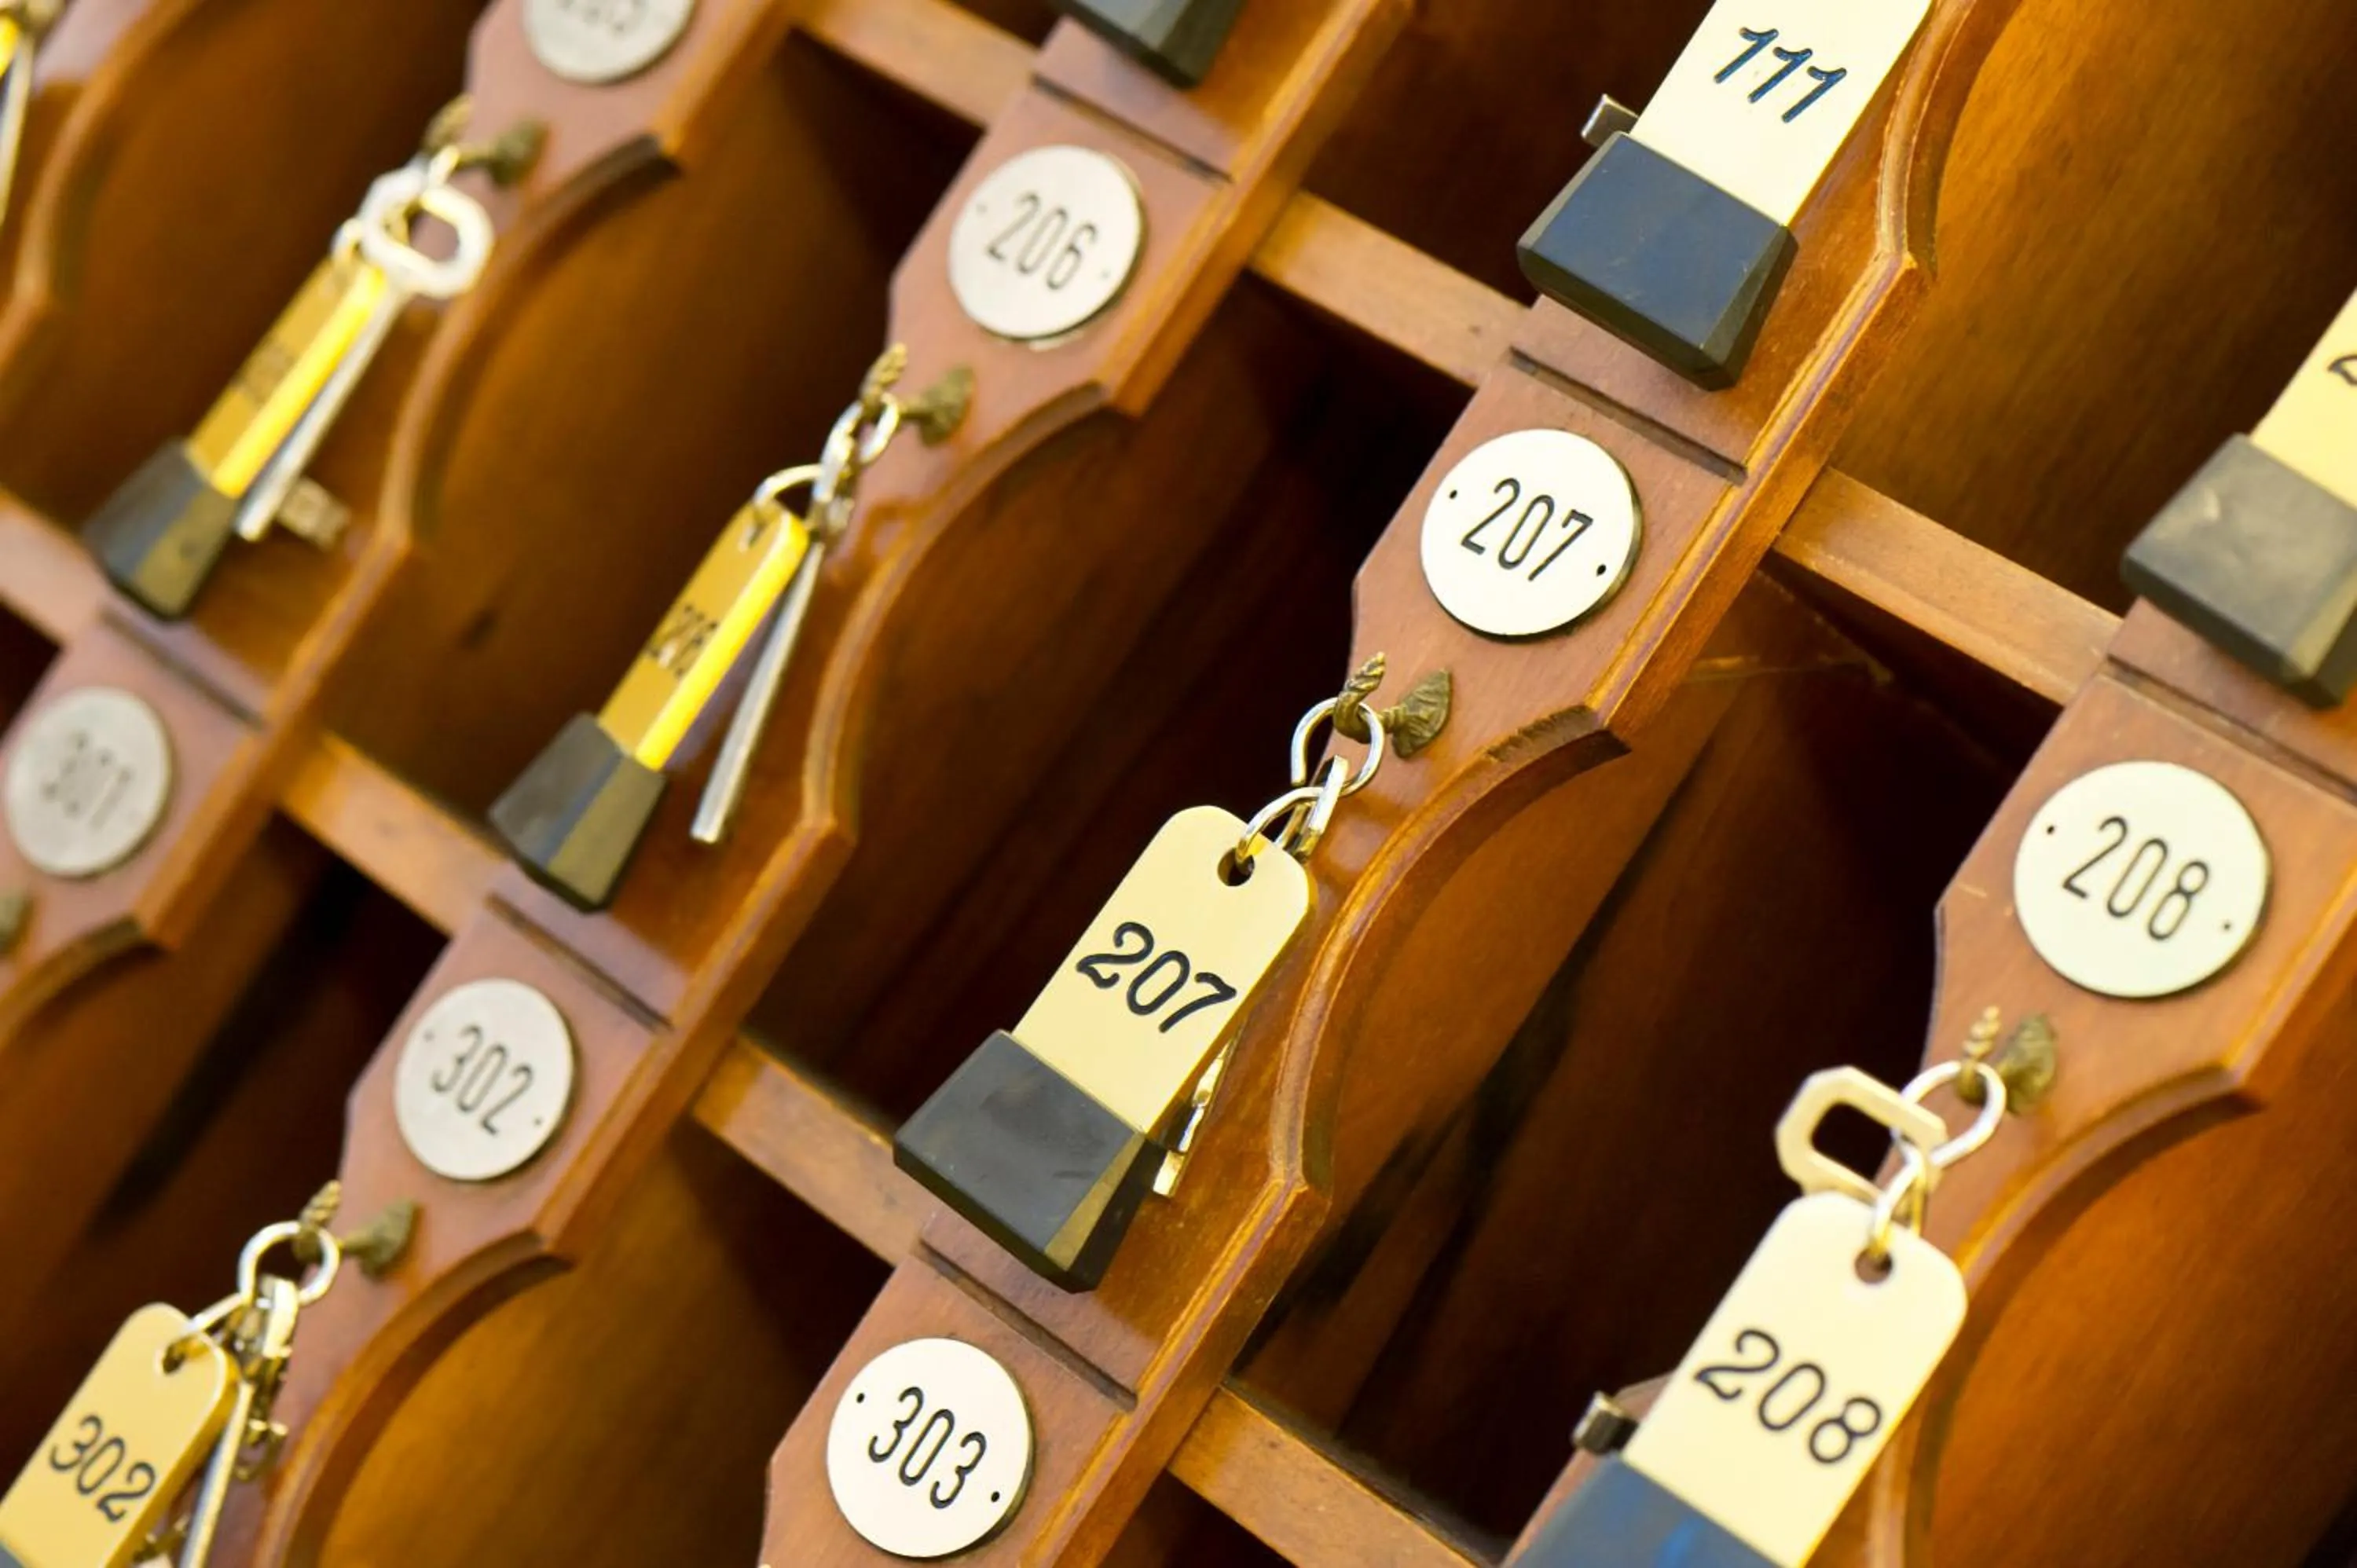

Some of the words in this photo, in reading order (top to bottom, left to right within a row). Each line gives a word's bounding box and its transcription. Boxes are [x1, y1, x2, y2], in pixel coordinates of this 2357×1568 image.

[1713, 26, 1848, 124] 111
[984, 190, 1093, 293] 206
[1460, 477, 1594, 582] 207
[2060, 814, 2211, 943] 208
[1075, 921, 1237, 1034] 207
[430, 1023, 535, 1137] 302
[867, 1385, 988, 1511] 303
[1692, 1327, 1883, 1465] 208
[48, 1413, 157, 1525] 302
